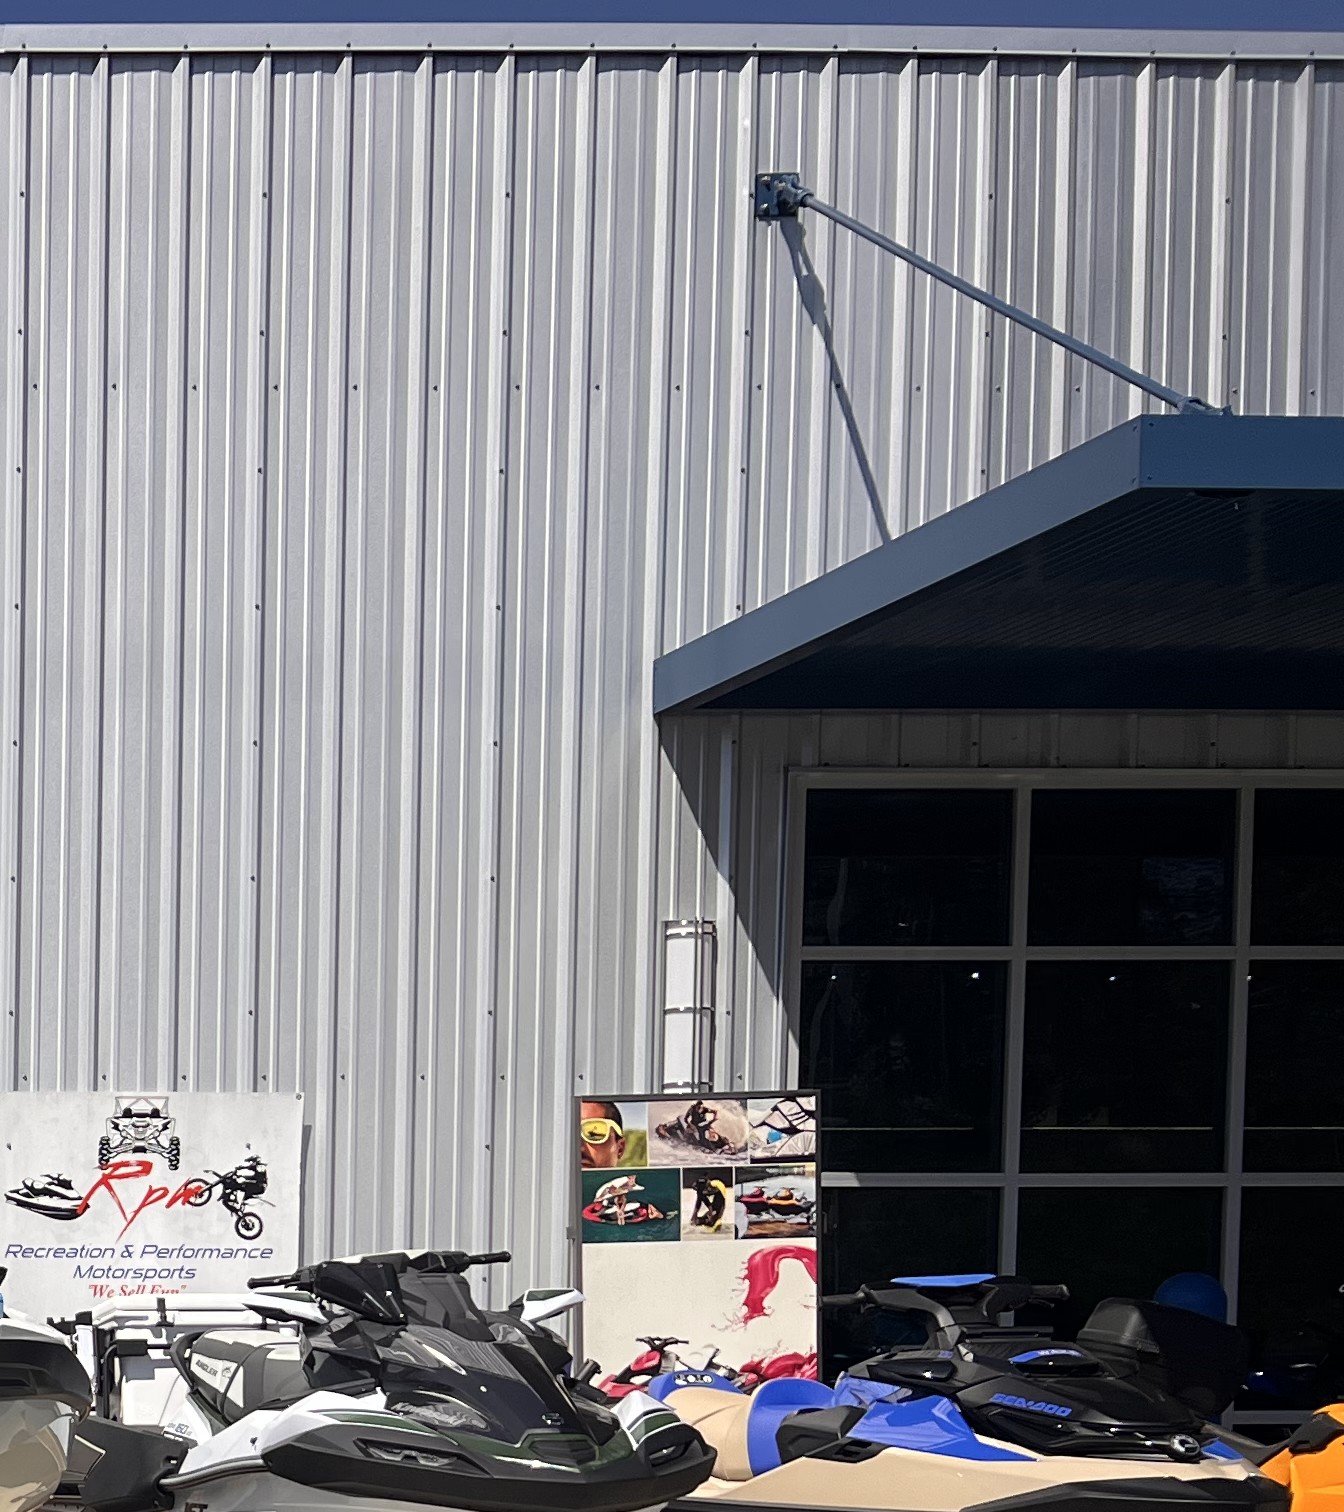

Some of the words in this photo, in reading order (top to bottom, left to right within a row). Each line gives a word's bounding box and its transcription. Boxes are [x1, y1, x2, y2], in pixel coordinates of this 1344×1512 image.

[4, 1243, 115, 1259] Recreation
[120, 1244, 135, 1259] &
[139, 1243, 274, 1260] Performance
[72, 1264, 197, 1283] Motorsports
